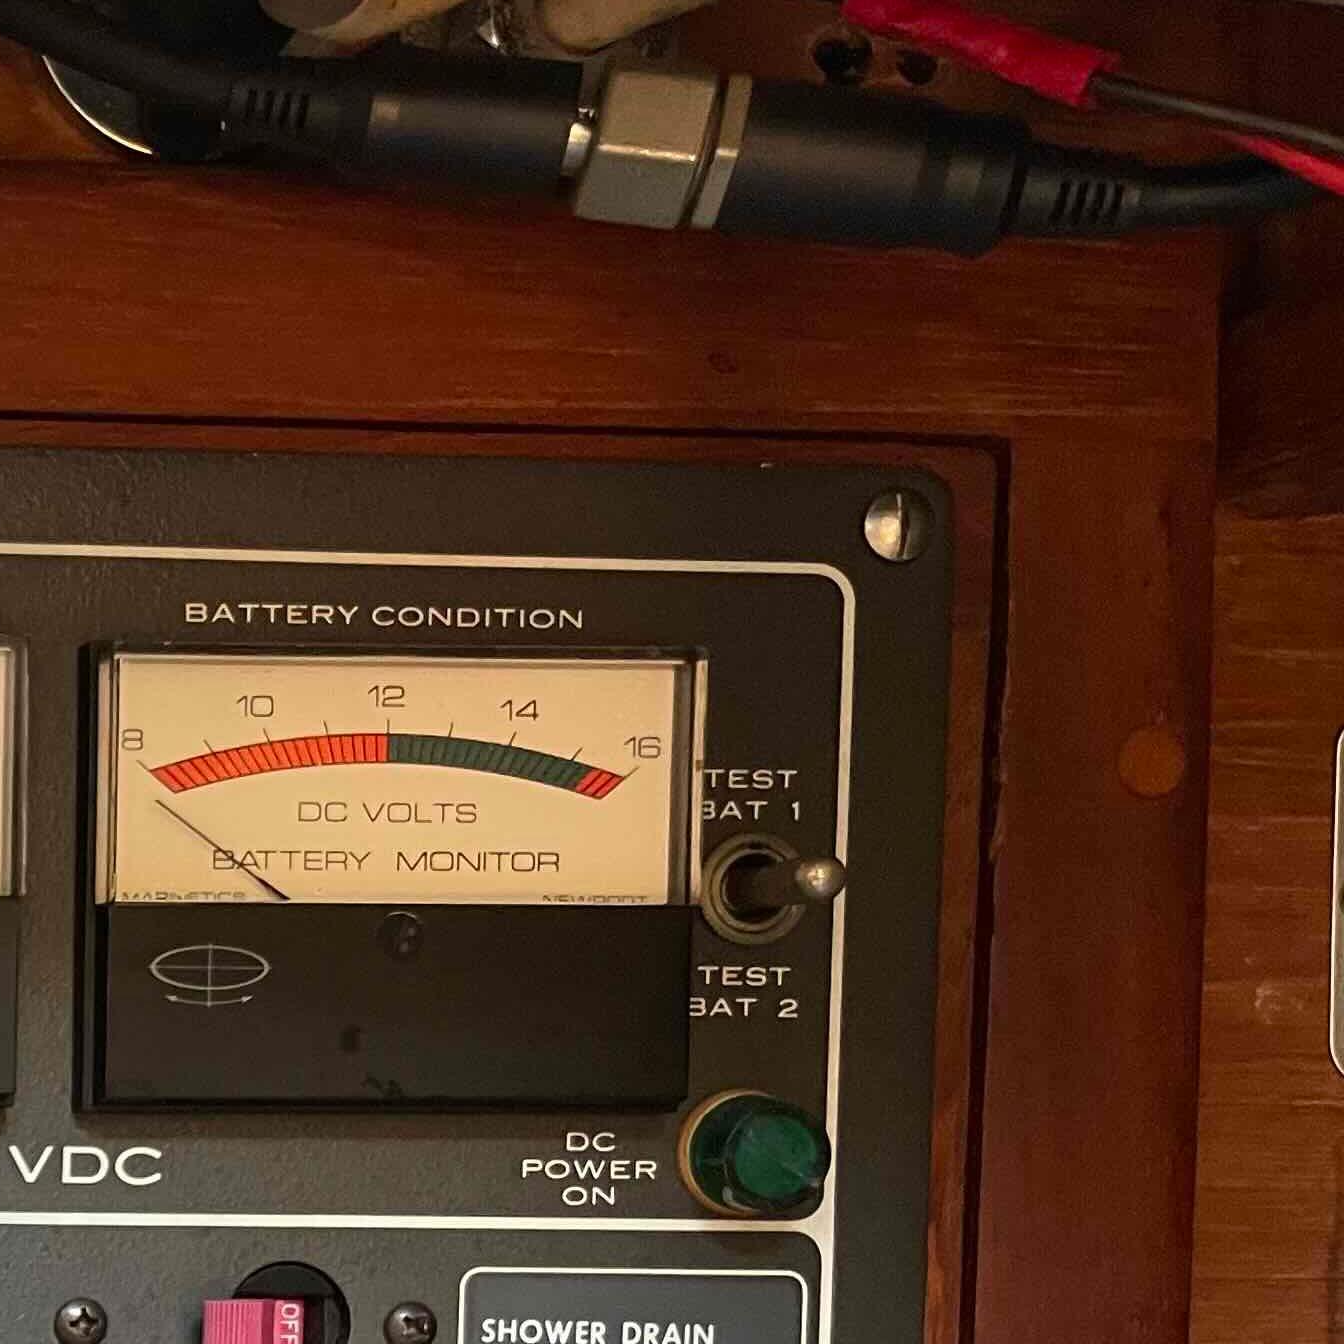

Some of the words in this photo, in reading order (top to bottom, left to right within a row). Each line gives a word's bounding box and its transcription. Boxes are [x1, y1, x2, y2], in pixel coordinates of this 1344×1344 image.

[184, 602, 358, 626] BATTERY
[371, 606, 584, 629] CONDITION
[121, 728, 144, 751] 8
[236, 696, 275, 718] 10
[368, 685, 406, 708] 12
[499, 699, 539, 721] 14
[623, 736, 661, 759] 16
[704, 768, 799, 790] TEST
[297, 802, 352, 823] DC
[362, 802, 477, 823] VOLTS
[701, 800, 773, 821] BAT
[790, 800, 801, 821] 1
[212, 850, 371, 872] BATTERY
[396, 851, 561, 873] MONITOR
[697, 966, 792, 986] TEST
[688, 997, 767, 1017] BAT
[779, 997, 799, 1018] 2
[566, 1132, 616, 1153] DC
[9, 1145, 162, 1185] VDC
[521, 1159, 657, 1180] POWER
[562, 1186, 616, 1206] ON
